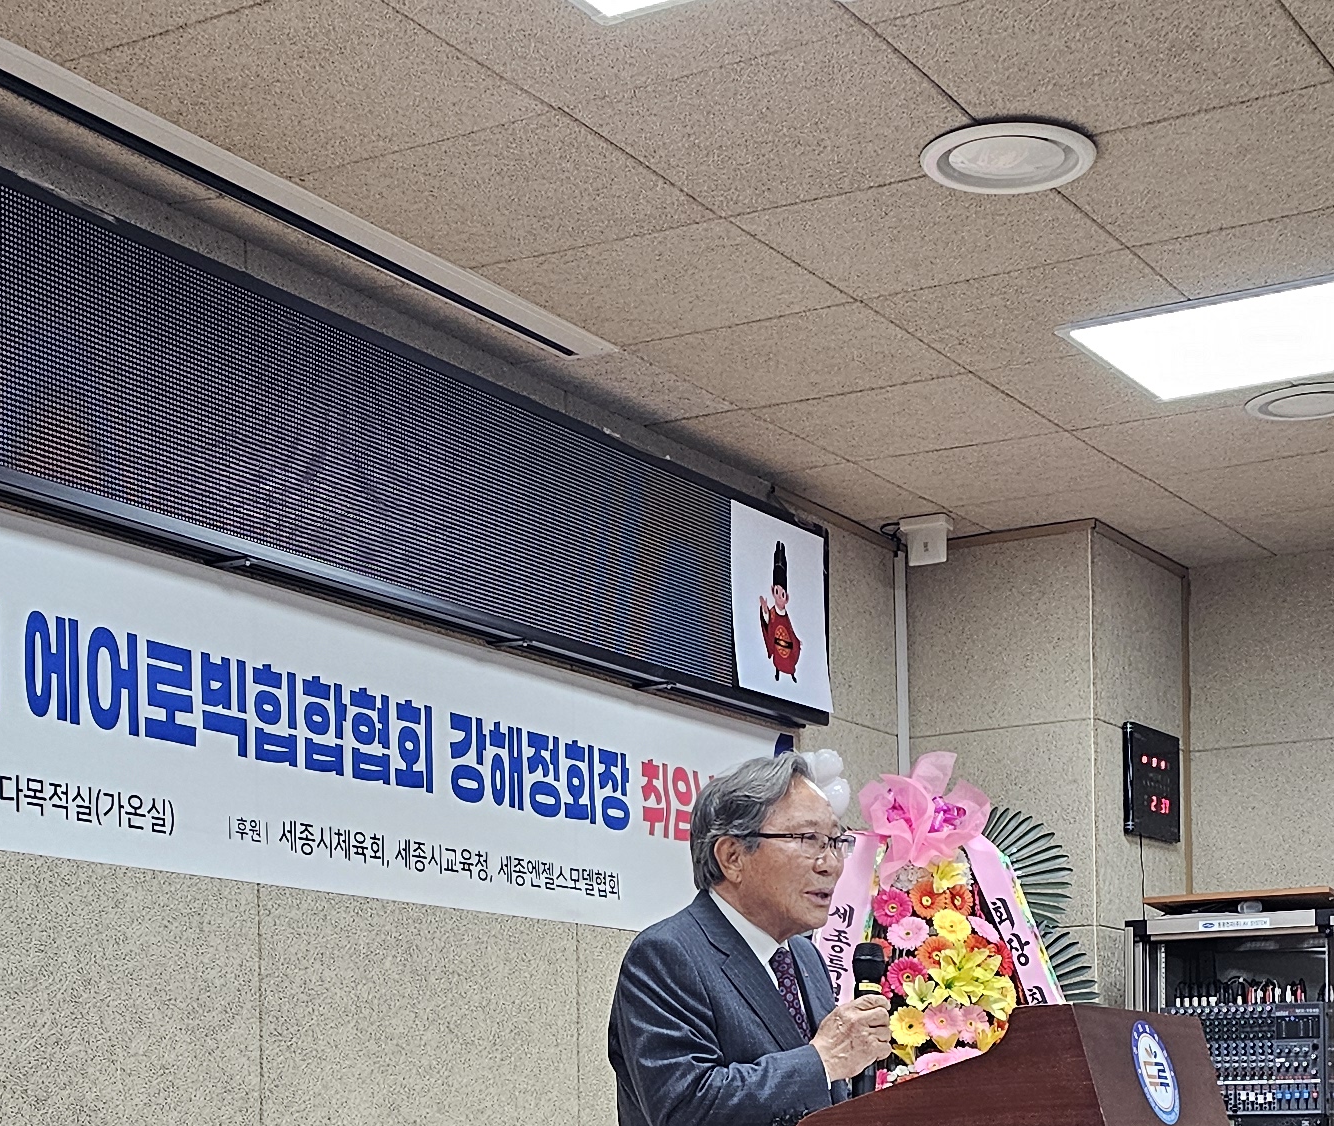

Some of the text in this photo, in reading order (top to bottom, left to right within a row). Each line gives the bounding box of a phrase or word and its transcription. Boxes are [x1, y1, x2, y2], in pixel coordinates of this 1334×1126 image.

[25, 611, 433, 792] 에어로빅힙합협회
[451, 713, 630, 830] 강해정회장
[641, 759, 714, 841] 취임
[0, 775, 174, 835] 다목적실(가온실)
[279, 821, 620, 899] 세종시체육회, 세종시교육청, 세종엔젤스모델협회
[990, 897, 1030, 967] 회장
